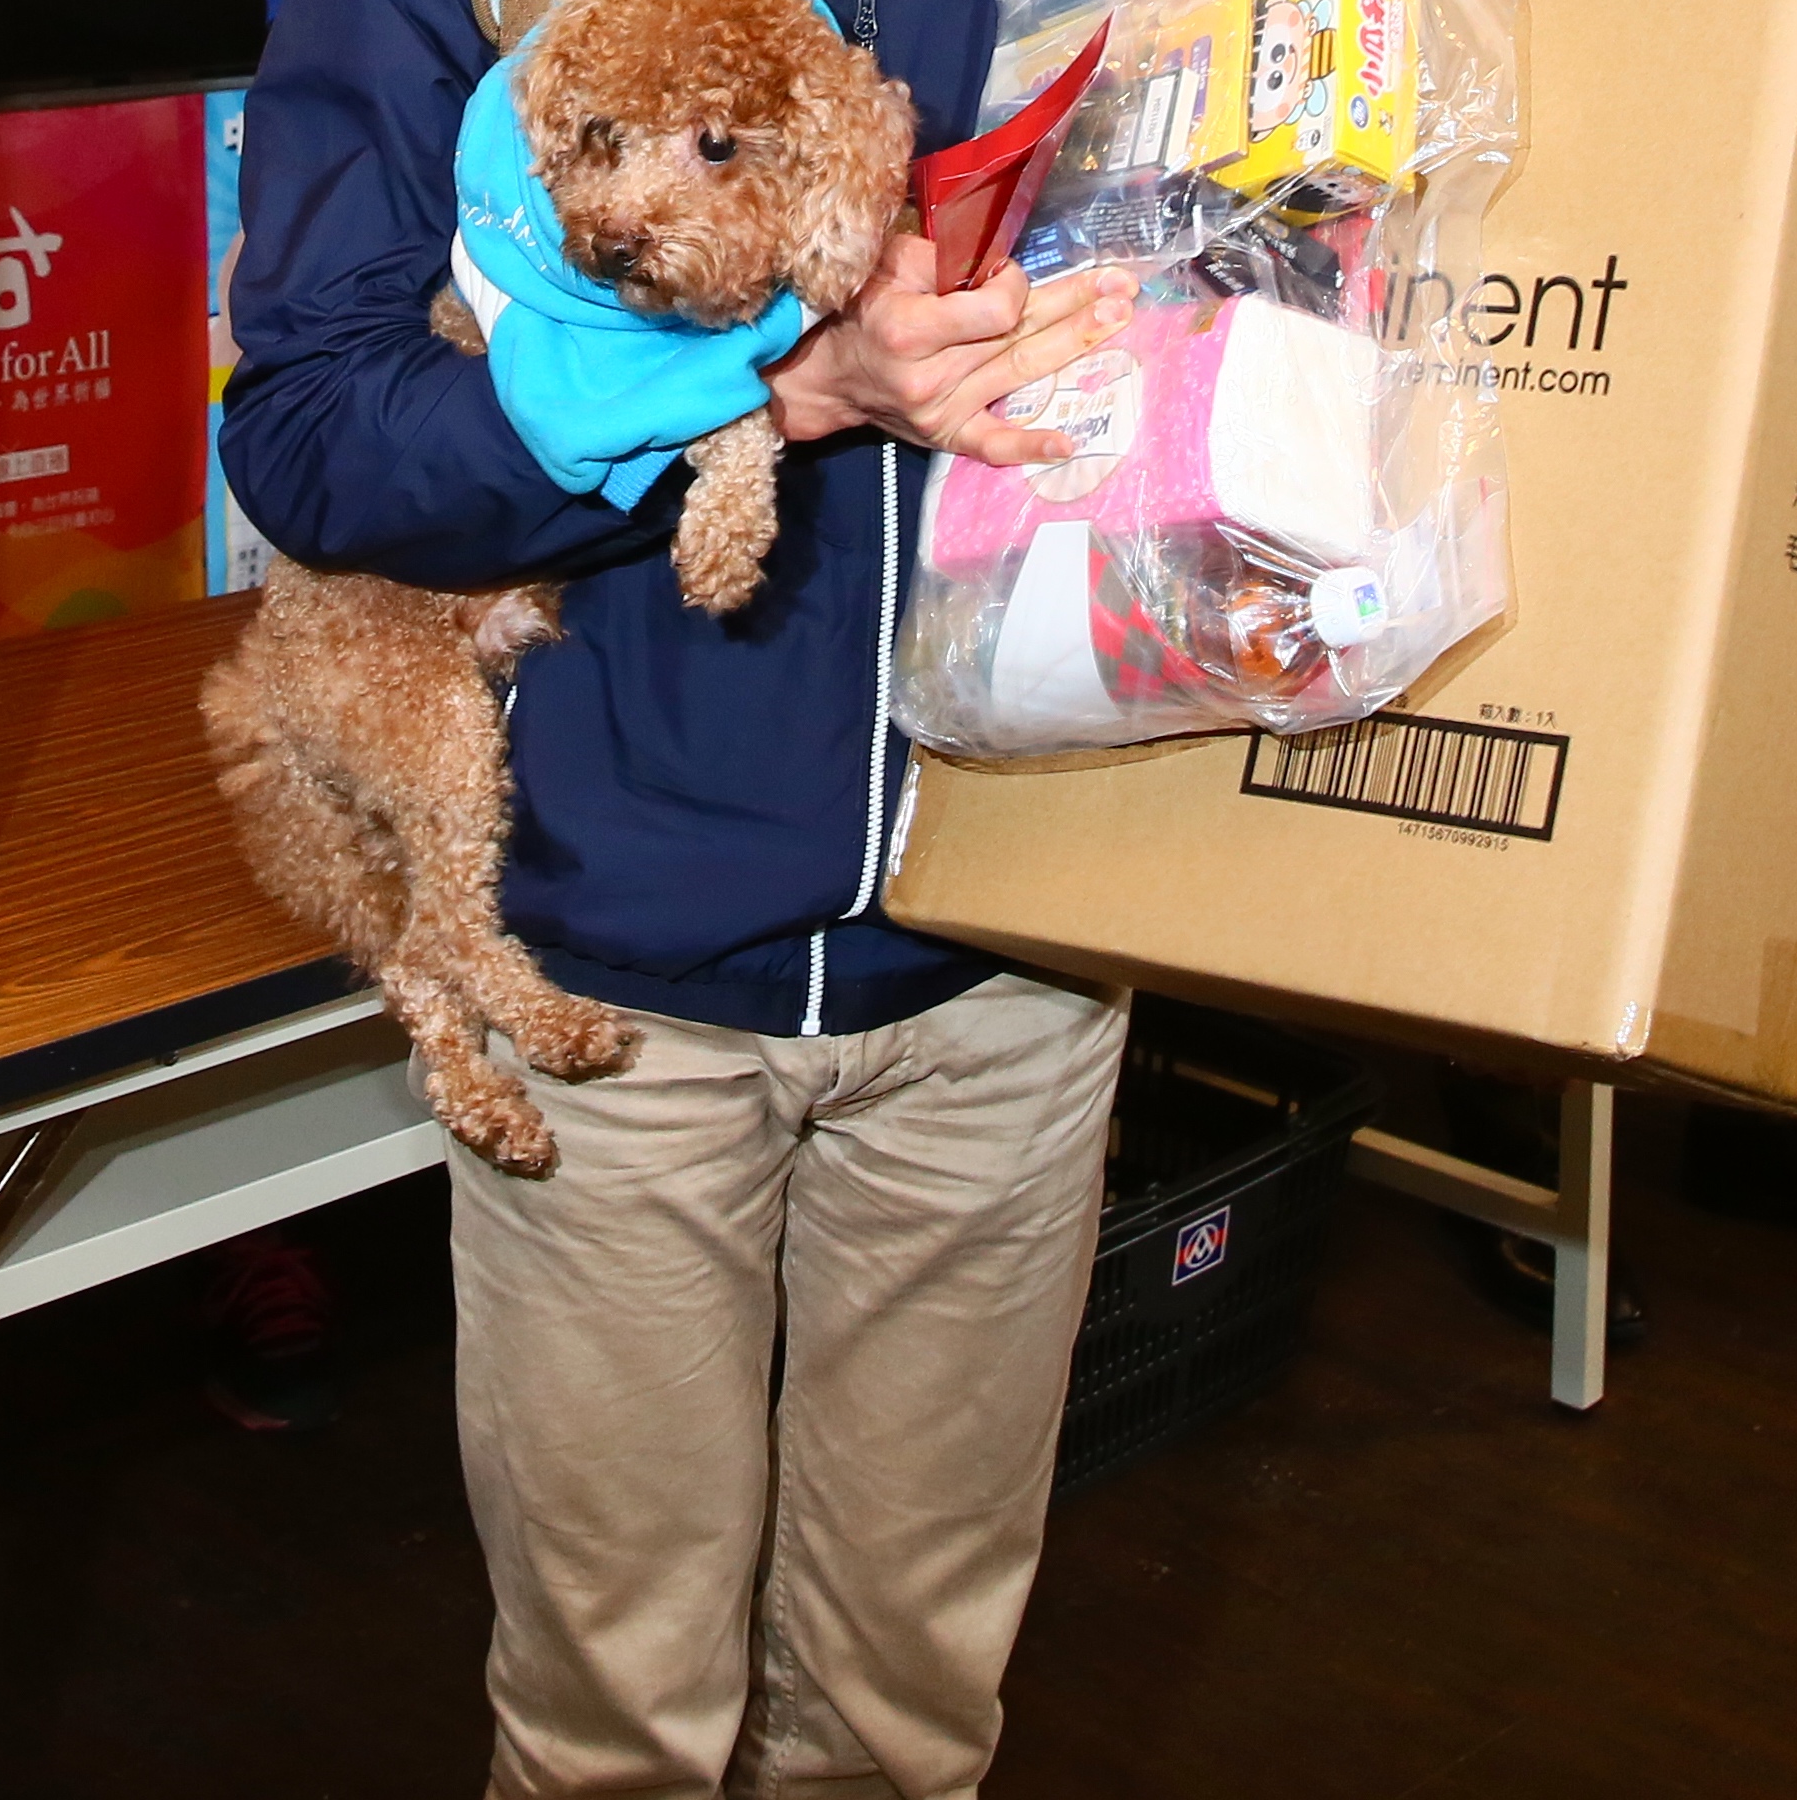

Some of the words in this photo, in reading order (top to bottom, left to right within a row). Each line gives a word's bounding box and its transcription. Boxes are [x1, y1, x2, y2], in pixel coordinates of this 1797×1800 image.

[1381, 253, 1628, 351] inent
[1, 341, 54, 383] for
[57, 329, 111, 375] All
